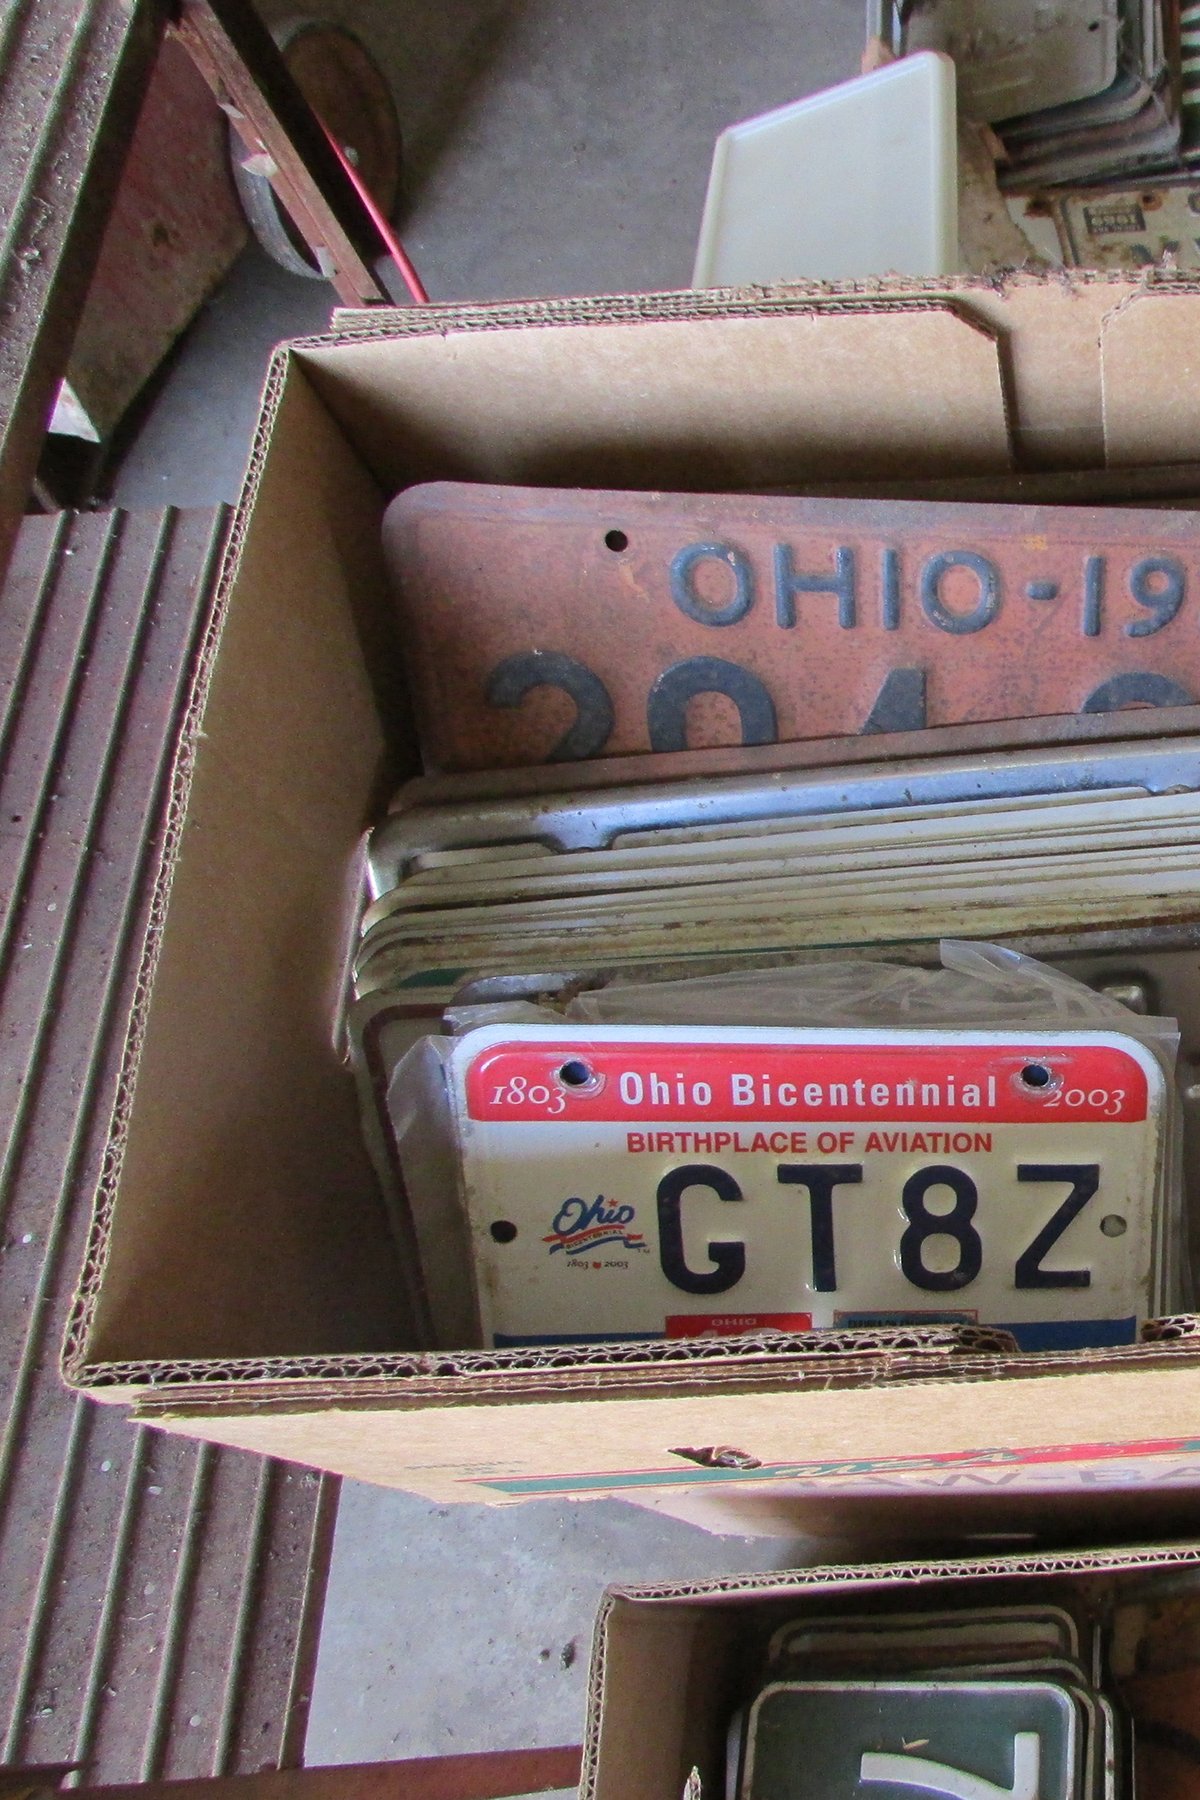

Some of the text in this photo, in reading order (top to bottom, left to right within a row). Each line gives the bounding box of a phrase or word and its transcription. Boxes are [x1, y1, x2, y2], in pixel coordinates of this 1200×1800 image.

[489, 1076, 567, 1114] 1803
[619, 1071, 997, 1108] Ohio Bicentennial
[1043, 1087, 1126, 1116] 2003
[626, 1131, 993, 1154] BIRTHPLACE OF AVIATION
[552, 1194, 636, 1237] Ohio
[710, 1317, 758, 1327] OHIO
